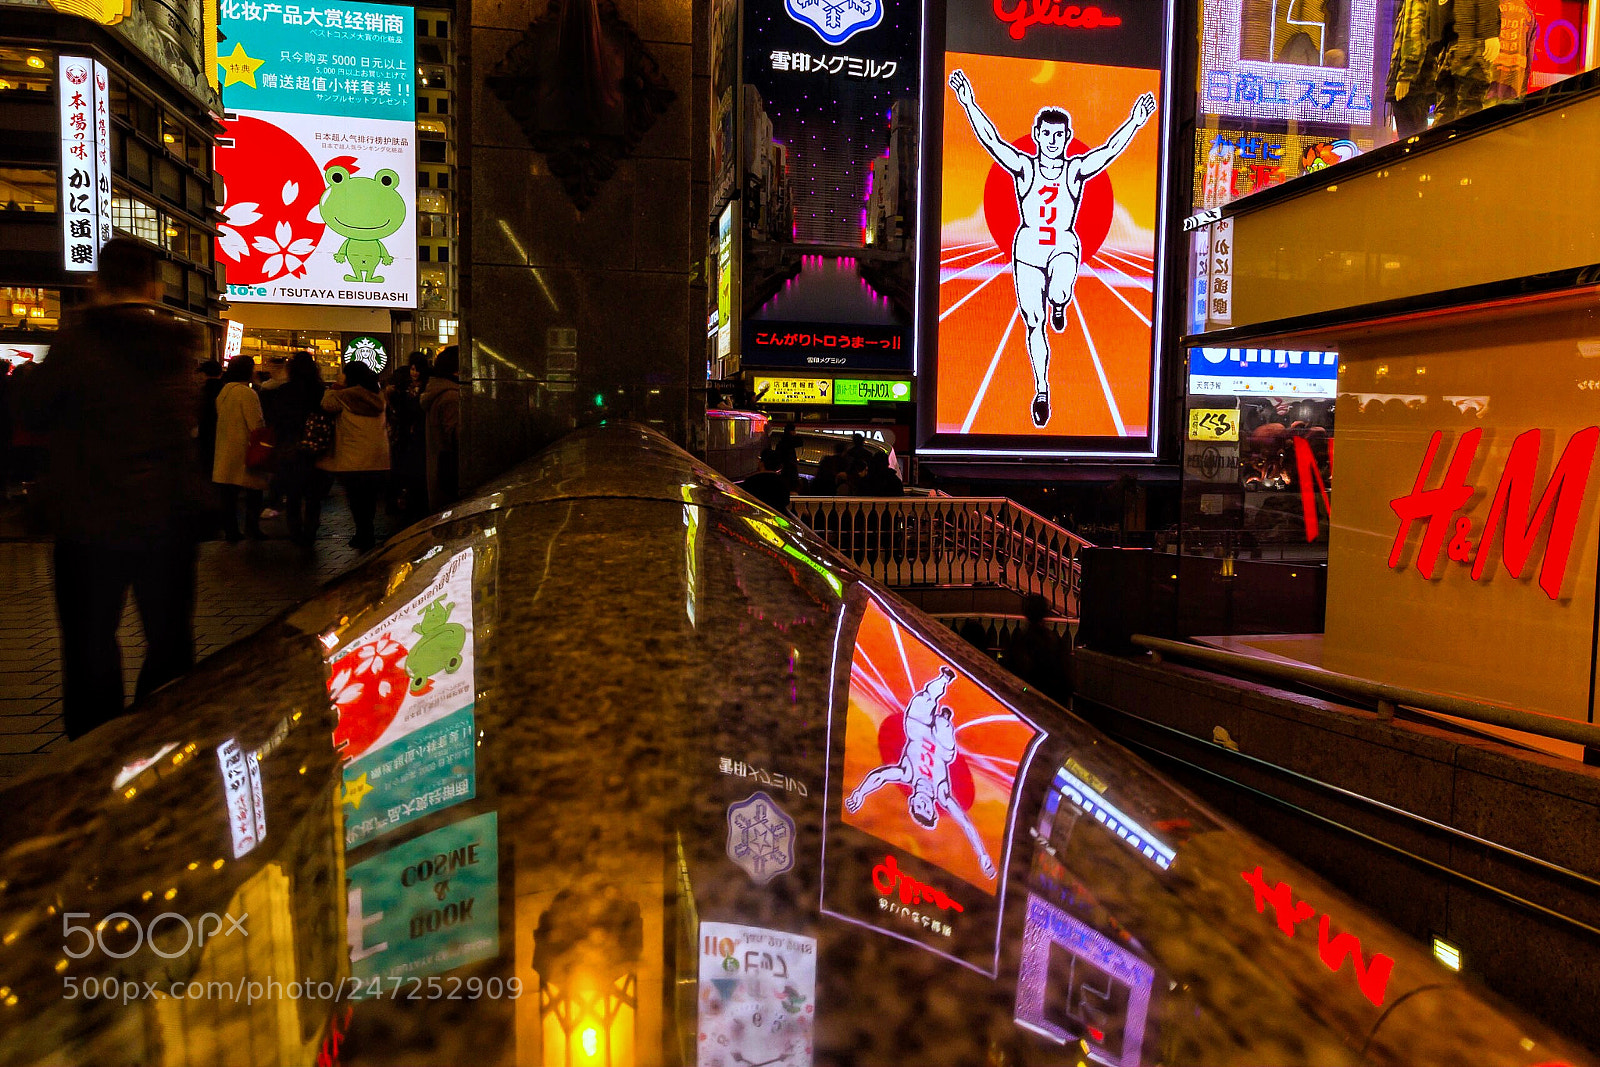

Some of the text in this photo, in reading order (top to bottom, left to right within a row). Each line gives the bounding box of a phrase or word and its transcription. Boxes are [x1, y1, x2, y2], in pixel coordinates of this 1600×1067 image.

[220, 0, 404, 34] 化妆产品大赏经销商
[310, 29, 403, 44] ベストコスメ大賞の化粧品
[230, 63, 250, 74] 特典
[280, 50, 407, 70] 只今购买 5000 日元以上
[770, 50, 897, 79] 雪印メグミルク
[262, 73, 392, 97] 赠送超值小样套装
[68, 90, 88, 161] 本場の味
[68, 167, 93, 264] かに道楽
[99, 172, 110, 243] かに道
[1037, 182, 1060, 247] グリコ
[279, 287, 335, 299] TSUTAYA
[338, 290, 409, 302] EBISUBASHI
[807, 356, 847, 365] 雪印メグミルク
[858, 382, 890, 399] ピタットハウス
[1388, 425, 1600, 600] H&M
